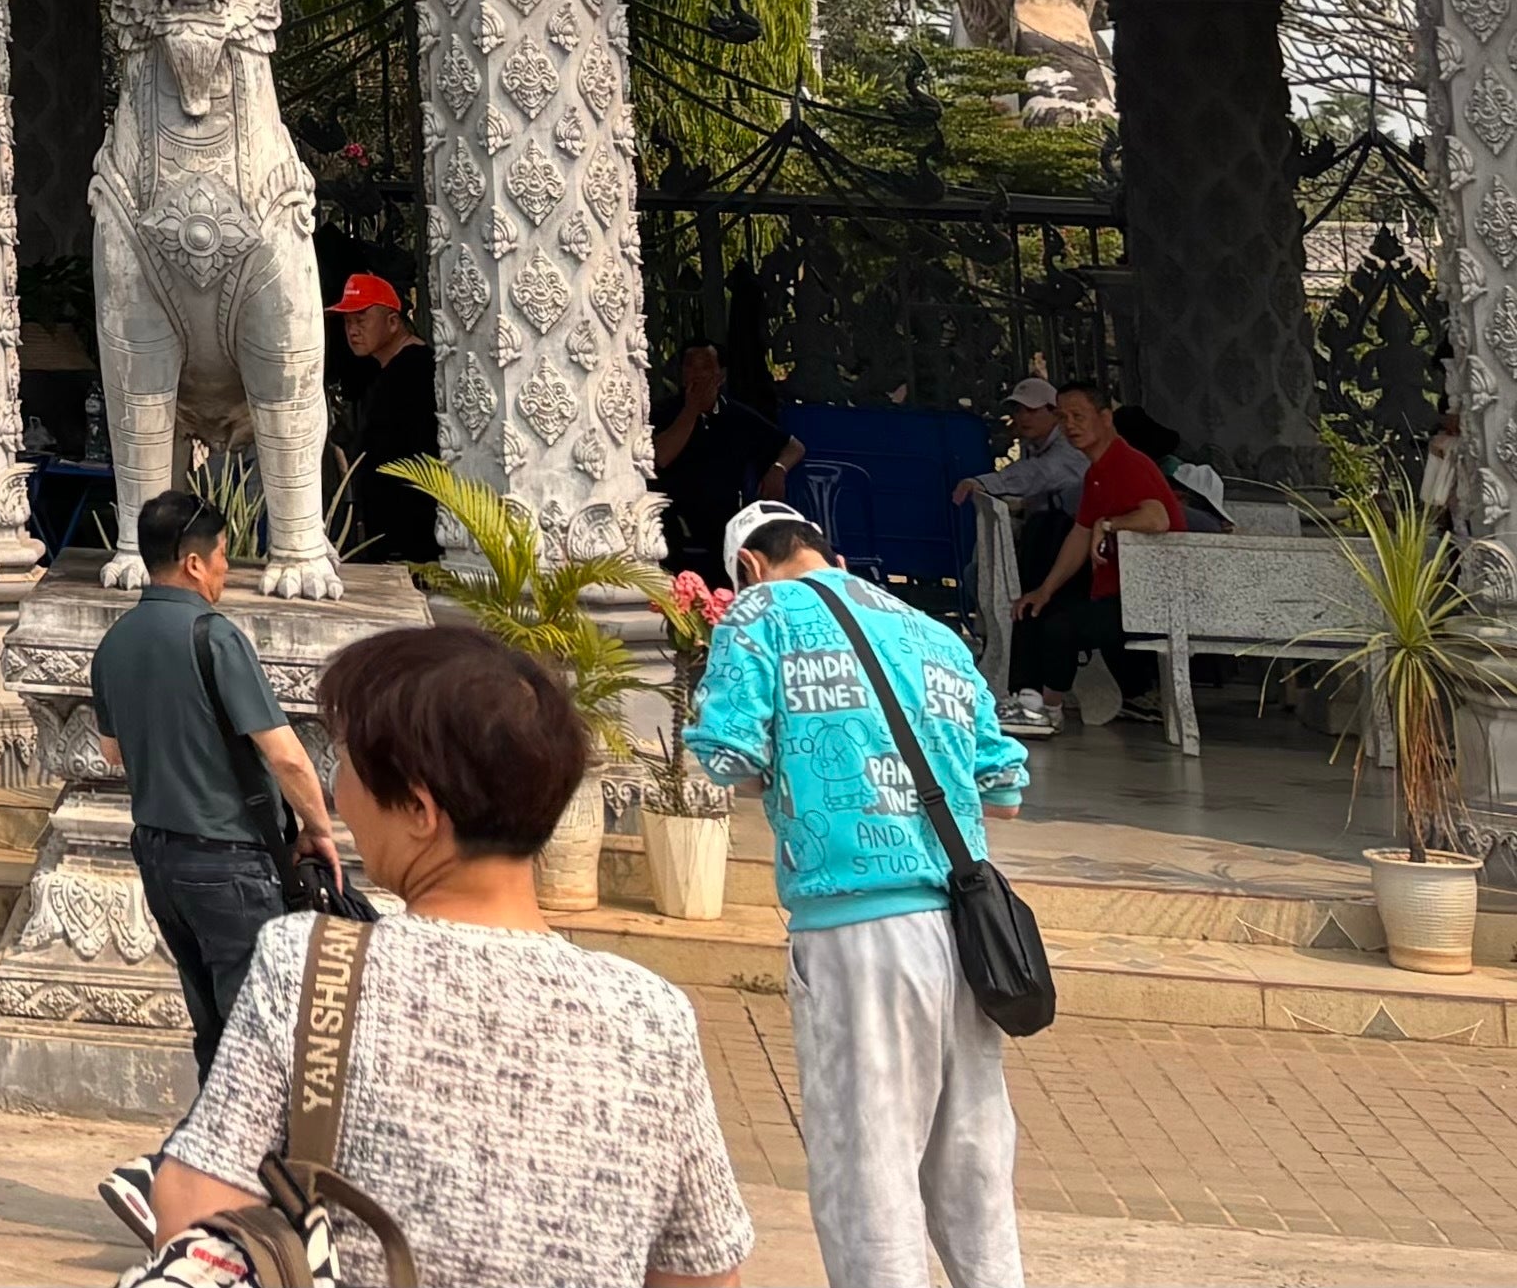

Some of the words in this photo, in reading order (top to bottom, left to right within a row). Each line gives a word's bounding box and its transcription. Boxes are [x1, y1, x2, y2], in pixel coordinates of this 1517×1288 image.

[783, 652, 857, 686] PANDA
[785, 683, 868, 712] STNET
[923, 664, 976, 706] PANDA
[869, 758, 915, 786] PAN
[884, 785, 918, 812] TNE
[857, 822, 913, 849] AND
[852, 854, 932, 874] STUDI
